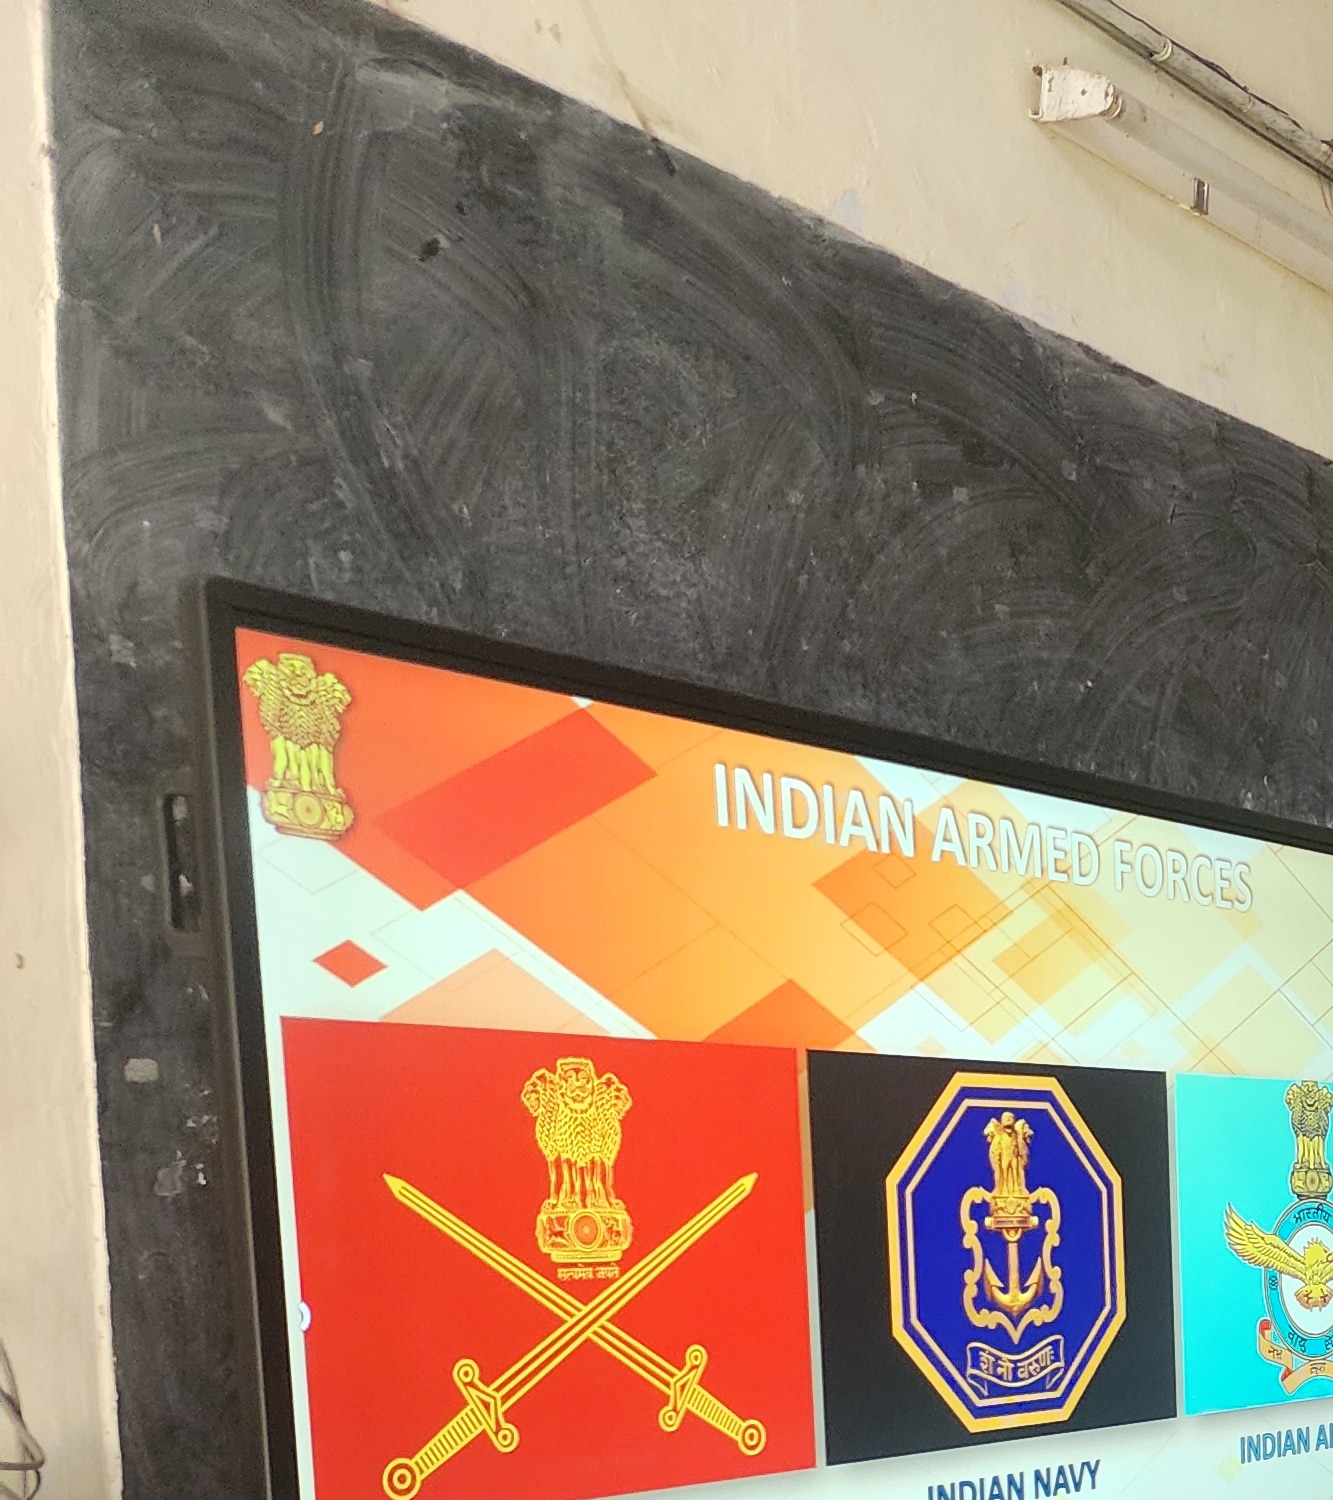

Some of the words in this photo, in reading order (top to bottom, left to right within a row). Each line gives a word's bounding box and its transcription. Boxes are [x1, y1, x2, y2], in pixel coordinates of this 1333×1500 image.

[714, 763, 916, 858] INDIAN
[931, 806, 1100, 887] ARMED
[1113, 840, 1253, 913] FORCES
[1239, 1428, 1309, 1466] INDIAN
